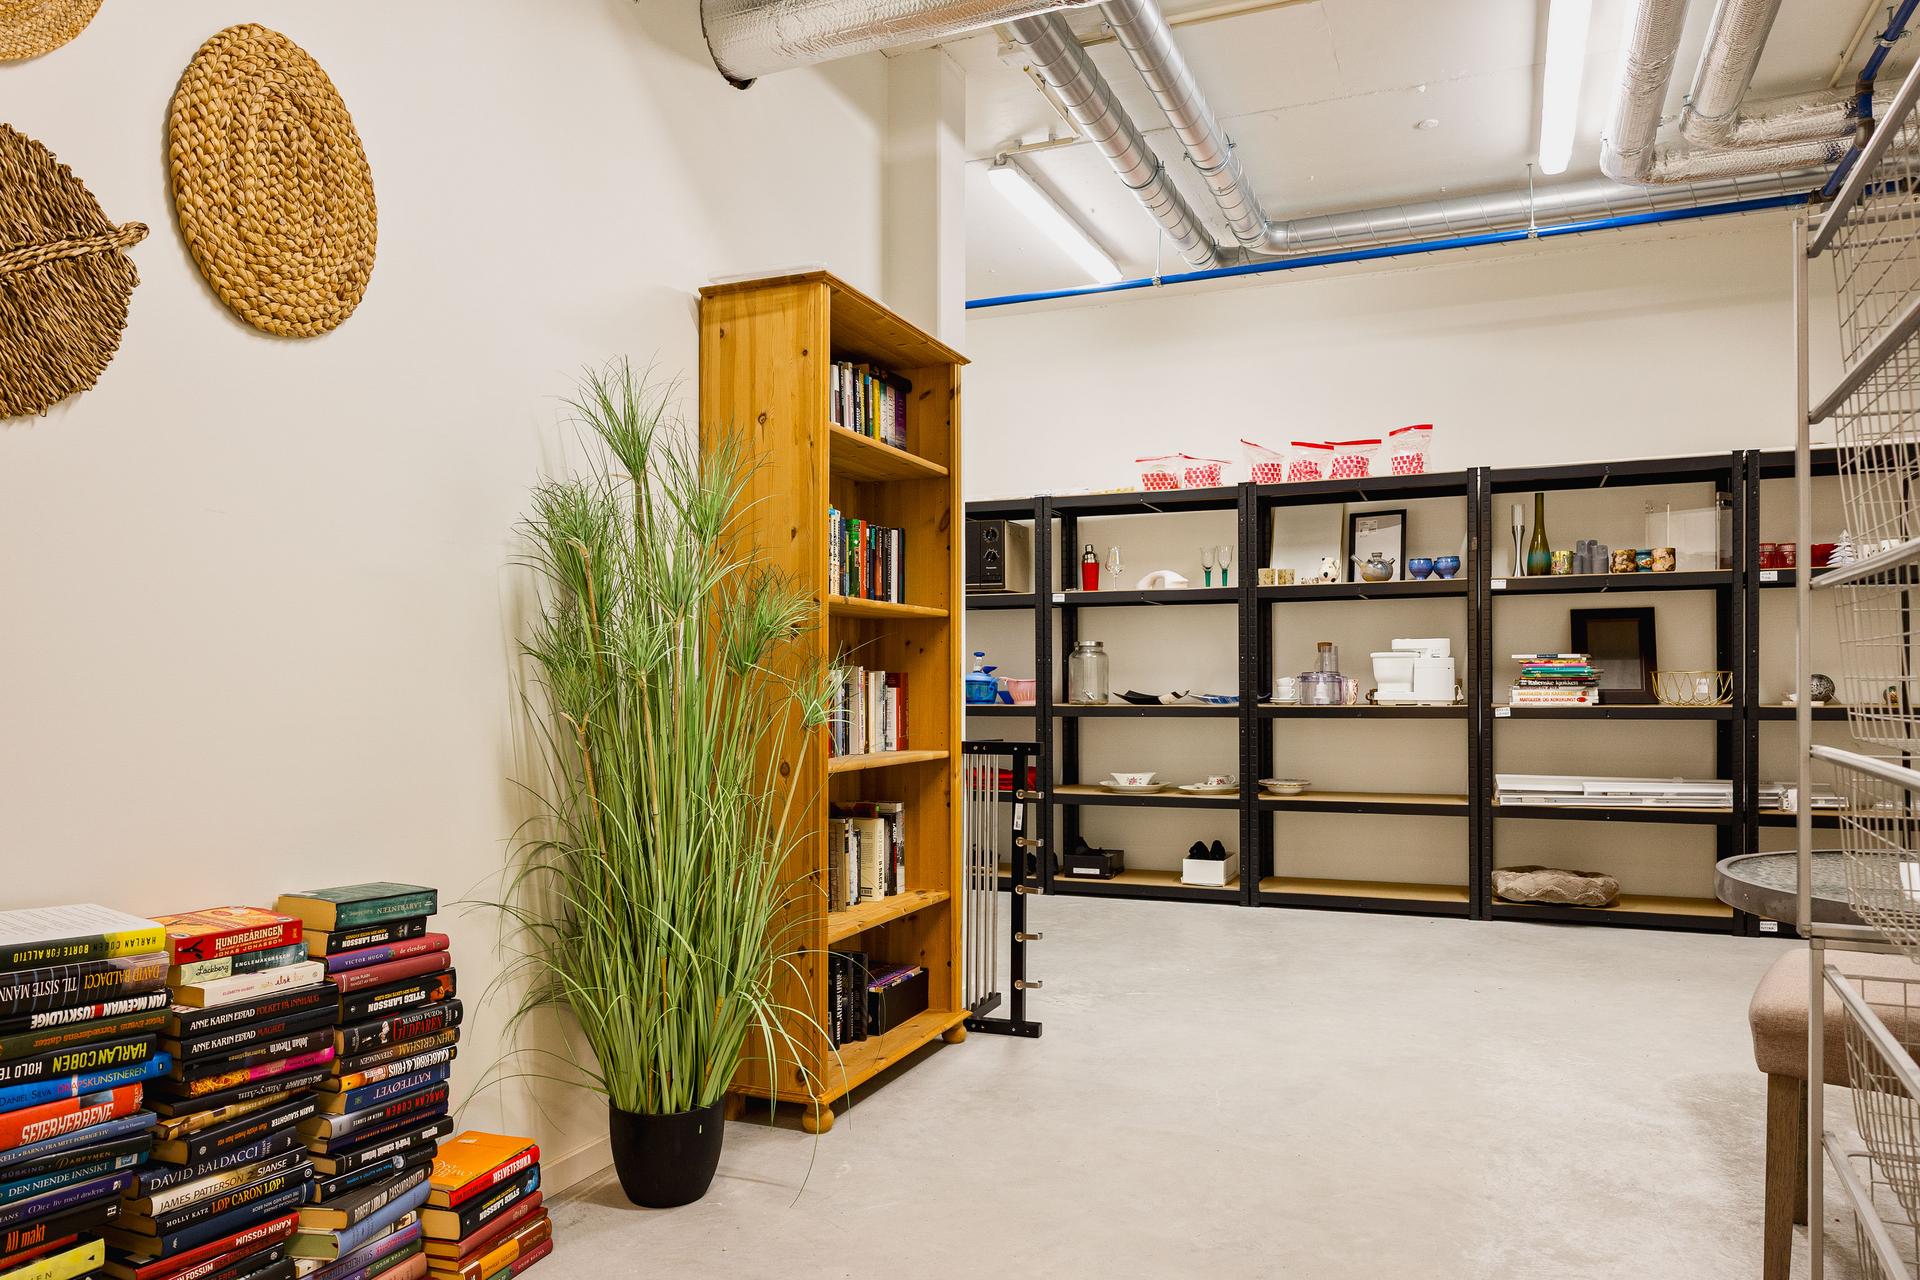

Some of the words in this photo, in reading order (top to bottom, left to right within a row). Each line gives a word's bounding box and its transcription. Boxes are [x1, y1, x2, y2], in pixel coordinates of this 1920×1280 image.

[376, 901, 422, 915] LABYRINTEN
[124, 936, 157, 949] HARLAN
[215, 924, 283, 951] HUNDREÅRINGEN
[341, 935, 371, 949] LARSSON
[371, 932, 389, 943] STIEG
[13, 949, 44, 964] ALLTID
[46, 947, 61, 959] FOR
[63, 943, 89, 956] BORTE
[214, 948, 240, 959] JONAS
[243, 938, 283, 952] JONASSON
[406, 944, 427, 954] elendige
[344, 957, 367, 966] VICTOR
[367, 953, 384, 961] HUGO
[84, 969, 130, 990] BALDACCI
[129, 964, 161, 983] DAVID
[275, 975, 291, 987] elsk
[0, 984, 30, 1002] MANN
[32, 979, 59, 998] SISTE
[63, 976, 78, 993] TIL
[149, 993, 167, 1008] IAN
[367, 995, 403, 1013] LARSSON
[404, 991, 426, 1003] STIEG
[189, 1017, 210, 1031] ANNE
[210, 1014, 233, 1027] KARIN
[256, 1002, 281, 1017] FOLKET
[402, 1014, 424, 1025] MARIO
[393, 1015, 443, 1040] GUDFAREN
[191, 1040, 211, 1054] ANNE
[210, 1035, 235, 1050] KARIN
[291, 1036, 309, 1048] Johan
[398, 1033, 436, 1055] GRISHAM
[436, 1030, 456, 1045] JOHN
[98, 1042, 147, 1065] HARLAN
[269, 1040, 292, 1054] Theorin
[52, 1051, 98, 1073] COBEN
[359, 1050, 394, 1066] STEVNINGEN
[405, 1059, 413, 1072] &
[14, 1061, 43, 1079] HOLD
[388, 1061, 406, 1077] FRIIS
[57, 1066, 147, 1095] DRAPSKUNSTNEREN
[373, 1074, 431, 1100] KATTEØYET
[238, 1083, 282, 1099] Mary-Ann
[414, 1089, 445, 1107] HARLAN
[271, 1110, 300, 1127] SLAUGHTER
[299, 1105, 315, 1117] KARIN
[385, 1101, 412, 1118] COBEN
[19, 1103, 115, 1147] SEIERHERRENE
[22, 1146, 45, 1156] BARNA
[45, 1143, 57, 1152] FRA
[58, 1138, 73, 1148] MITT
[73, 1133, 98, 1143] FORRIGE
[98, 1128, 110, 1137] LIV
[151, 1167, 194, 1190] DAVID
[197, 1146, 259, 1176] BALDACCI
[256, 1158, 288, 1177] SJANSE
[8, 1183, 31, 1197] DEN
[32, 1173, 70, 1191] NIENDE
[71, 1162, 109, 1180] INNSIKT
[159, 1193, 191, 1213] JAMES
[193, 1176, 244, 1201] PATTERSON
[211, 1196, 234, 1215] LØP
[231, 1184, 263, 1206] CARON
[263, 1176, 286, 1196] LØP!
[503, 1187, 520, 1201] STIEG
[166, 1214, 190, 1228] MOLLY
[191, 1207, 209, 1218] KATZ
[479, 1197, 504, 1221] LARSSON
[267, 1218, 292, 1235] KARIN
[5, 1229, 19, 1253] All
[21, 1222, 47, 1247] makt
[235, 1229, 267, 1247] FOSSUM
[184, 1263, 214, 1280] FOSSUM
